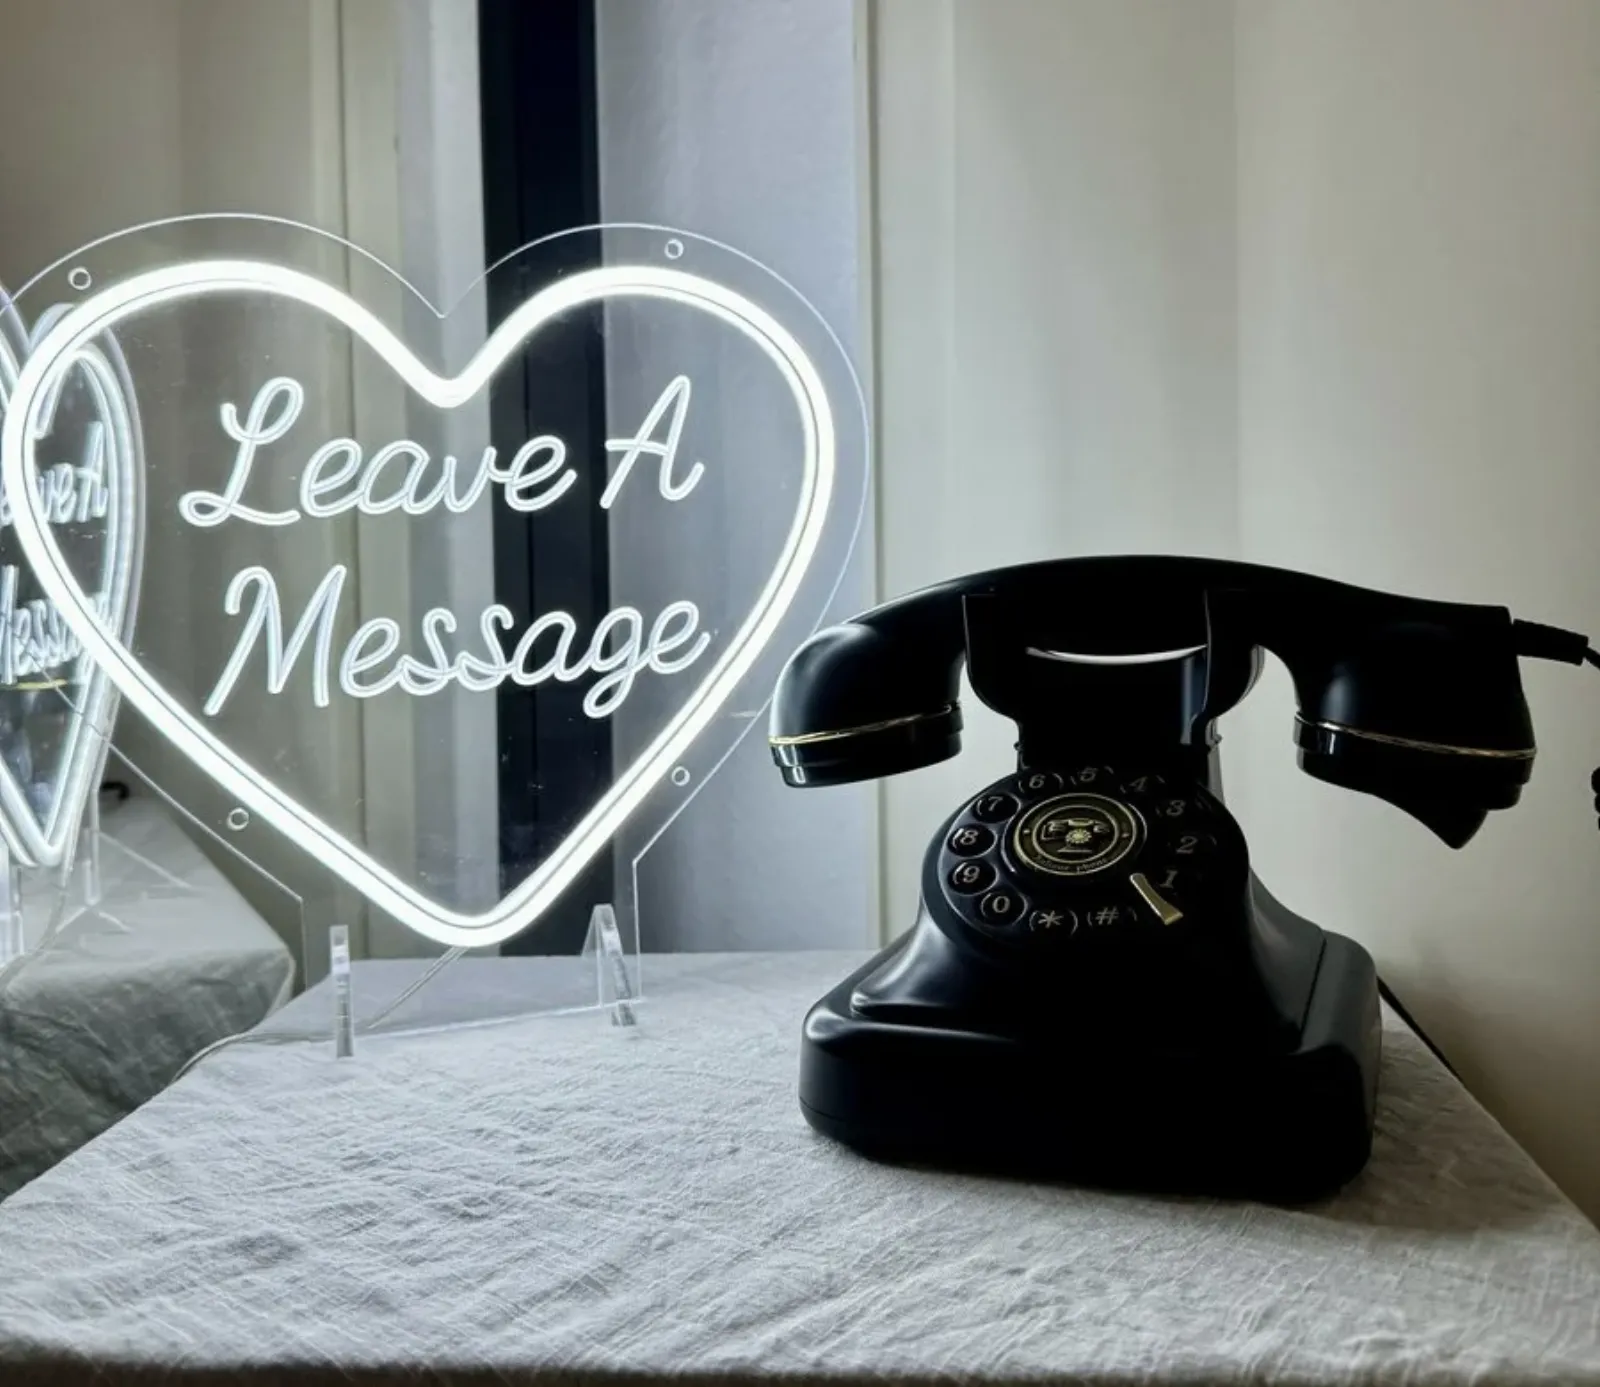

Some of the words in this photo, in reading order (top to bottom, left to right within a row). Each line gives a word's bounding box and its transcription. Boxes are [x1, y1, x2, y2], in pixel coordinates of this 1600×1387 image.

[179, 376, 577, 527] Leave
[600, 374, 705, 509] A
[204, 564, 711, 719] Message
[1029, 774, 1045, 788] 6
[1079, 767, 1098, 782] 5
[1129, 775, 1149, 793] 4
[986, 797, 1004, 811] 7
[1166, 799, 1186, 816] 3
[960, 830, 979, 846] 8
[1176, 836, 1198, 854] 2
[962, 865, 980, 883] 9
[1160, 869, 1178, 889] 1
[992, 896, 1010, 914] 0
